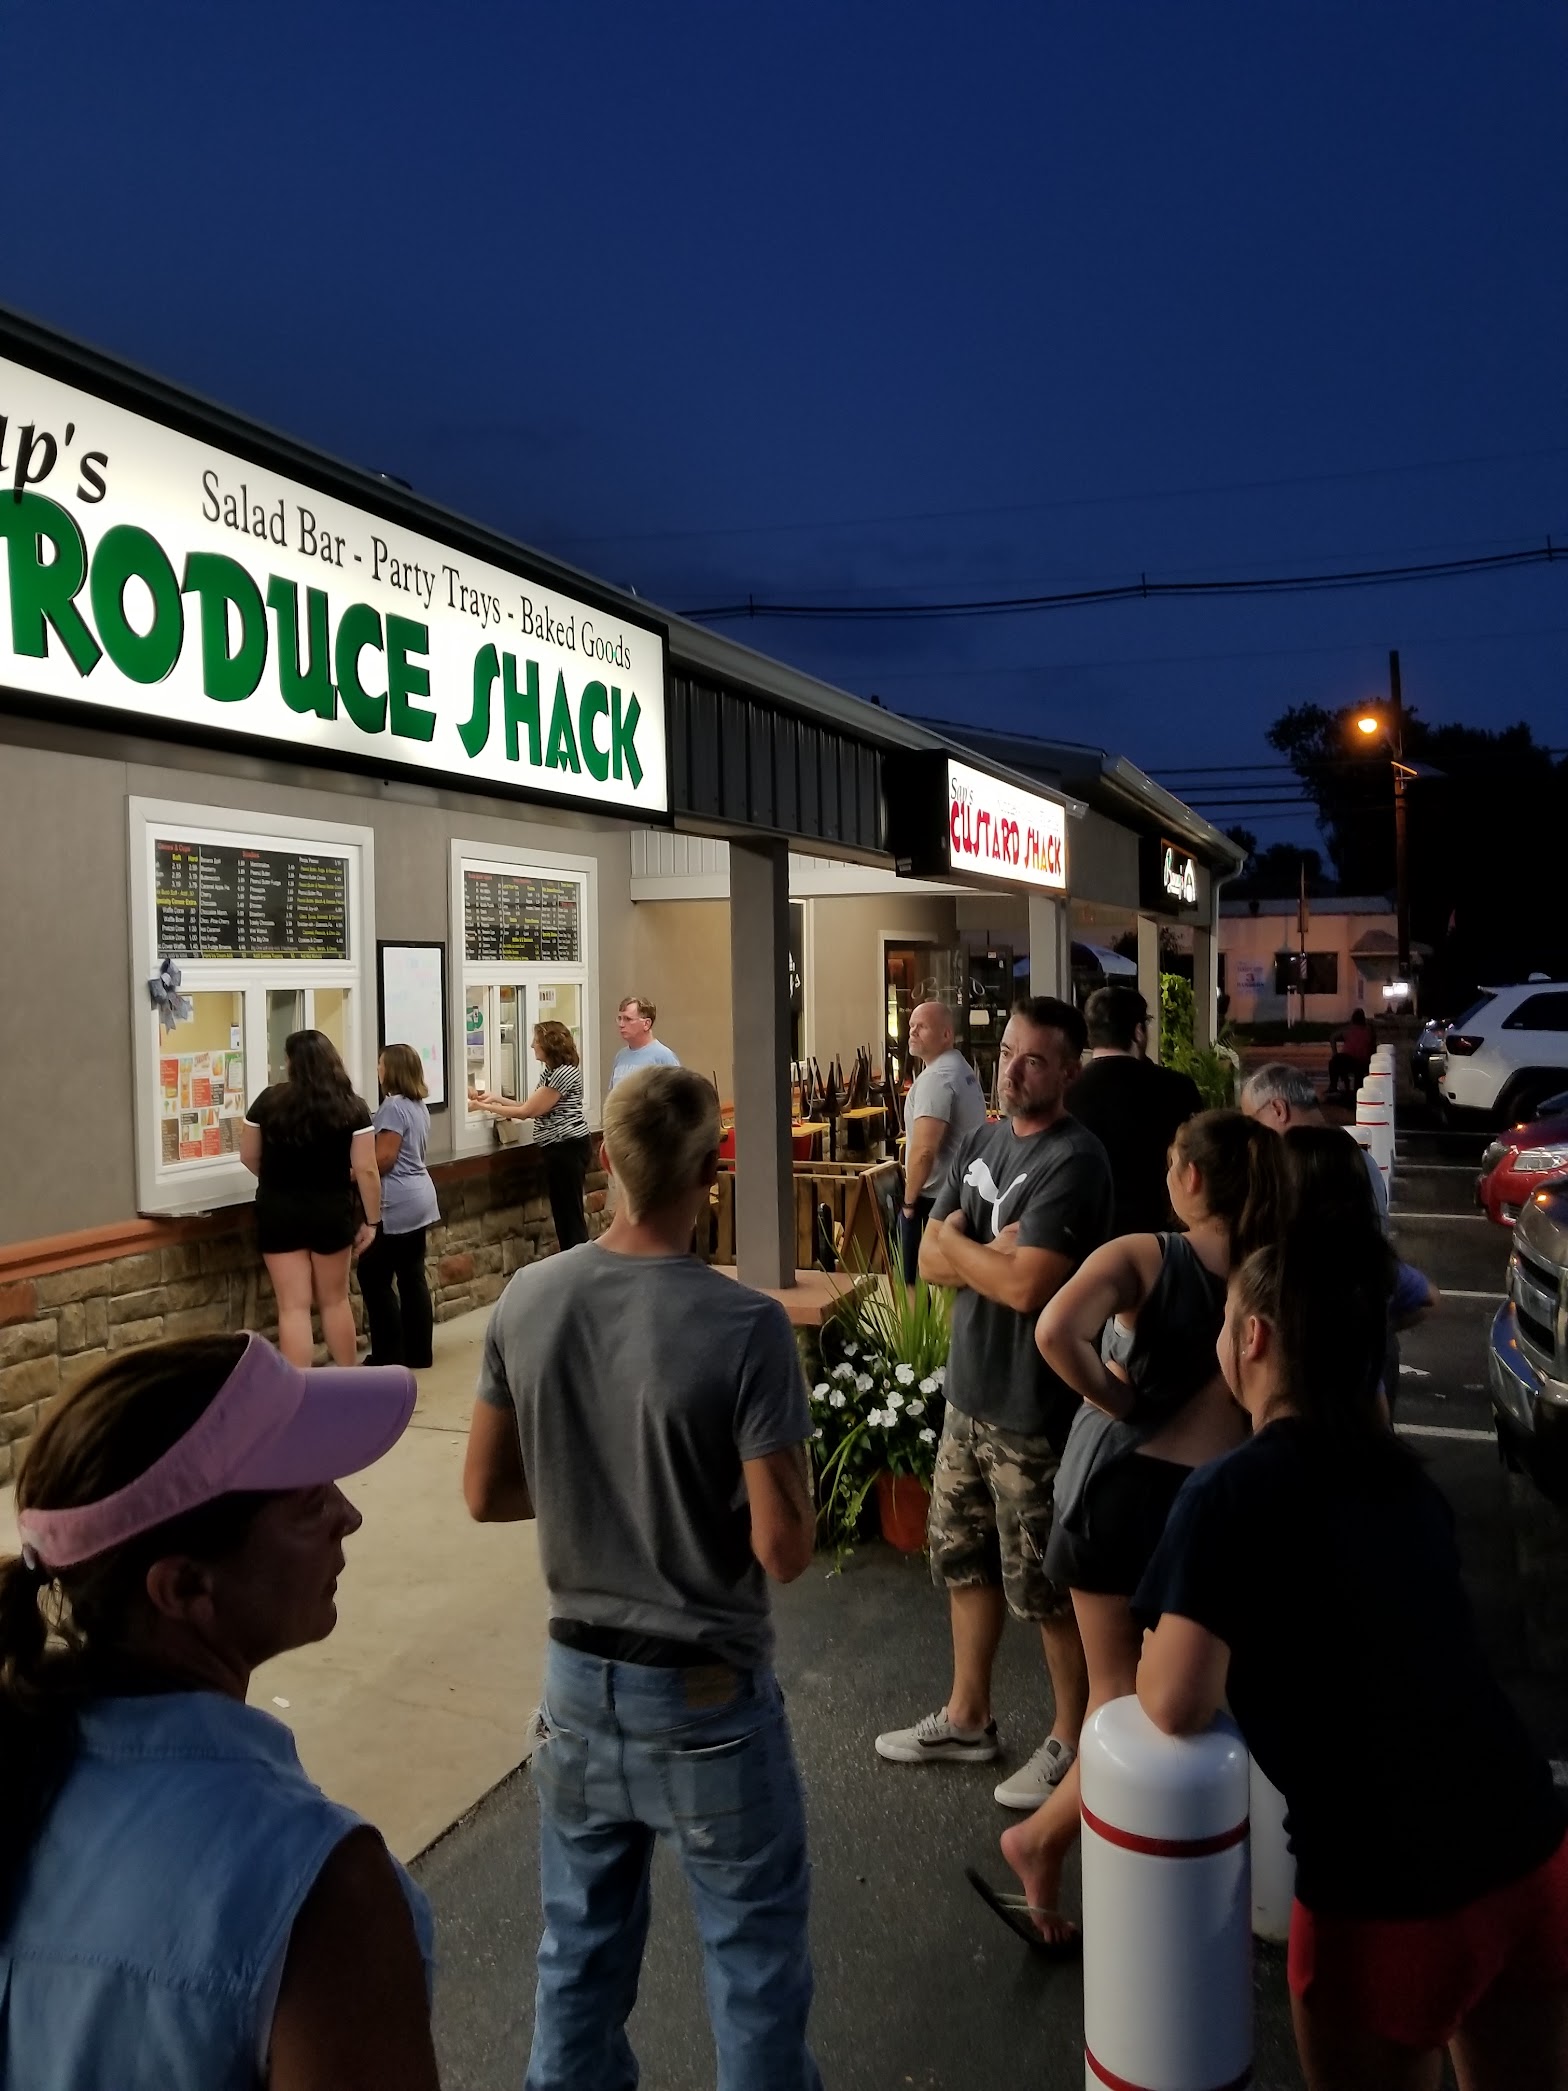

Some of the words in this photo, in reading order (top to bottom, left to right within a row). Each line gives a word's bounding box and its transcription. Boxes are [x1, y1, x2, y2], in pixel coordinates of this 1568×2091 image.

[0, 414, 109, 504] p's
[202, 470, 288, 547] Salad
[297, 505, 346, 569] Bar
[371, 536, 436, 609] Party
[441, 564, 501, 625] Trays
[520, 595, 577, 652] Baked
[581, 621, 632, 671] Goods
[456, 642, 644, 790] SHACK
[951, 800, 1020, 866] CUSTARD
[1024, 826, 1062, 877] SHACK
